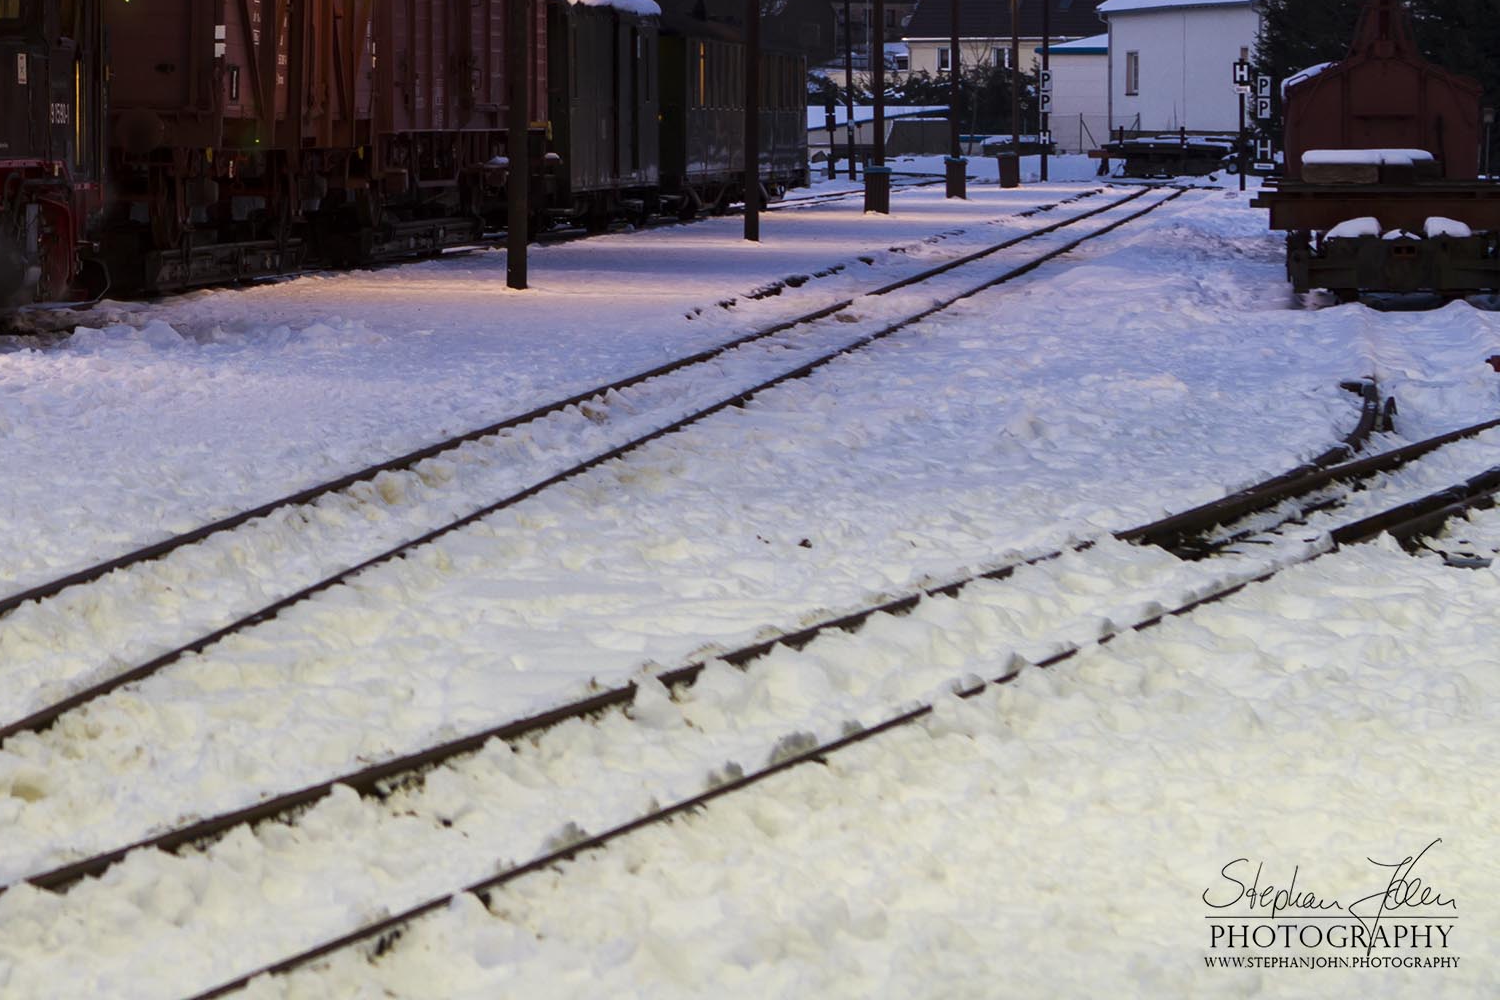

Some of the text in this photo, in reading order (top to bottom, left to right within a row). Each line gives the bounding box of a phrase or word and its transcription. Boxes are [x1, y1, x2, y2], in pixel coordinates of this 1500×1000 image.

[1041, 73, 1051, 89] P
[1235, 64, 1249, 82] H
[1259, 78, 1269, 95] P
[1041, 95, 1051, 111] P
[1259, 100, 1269, 117] P
[1256, 139, 1272, 160] H
